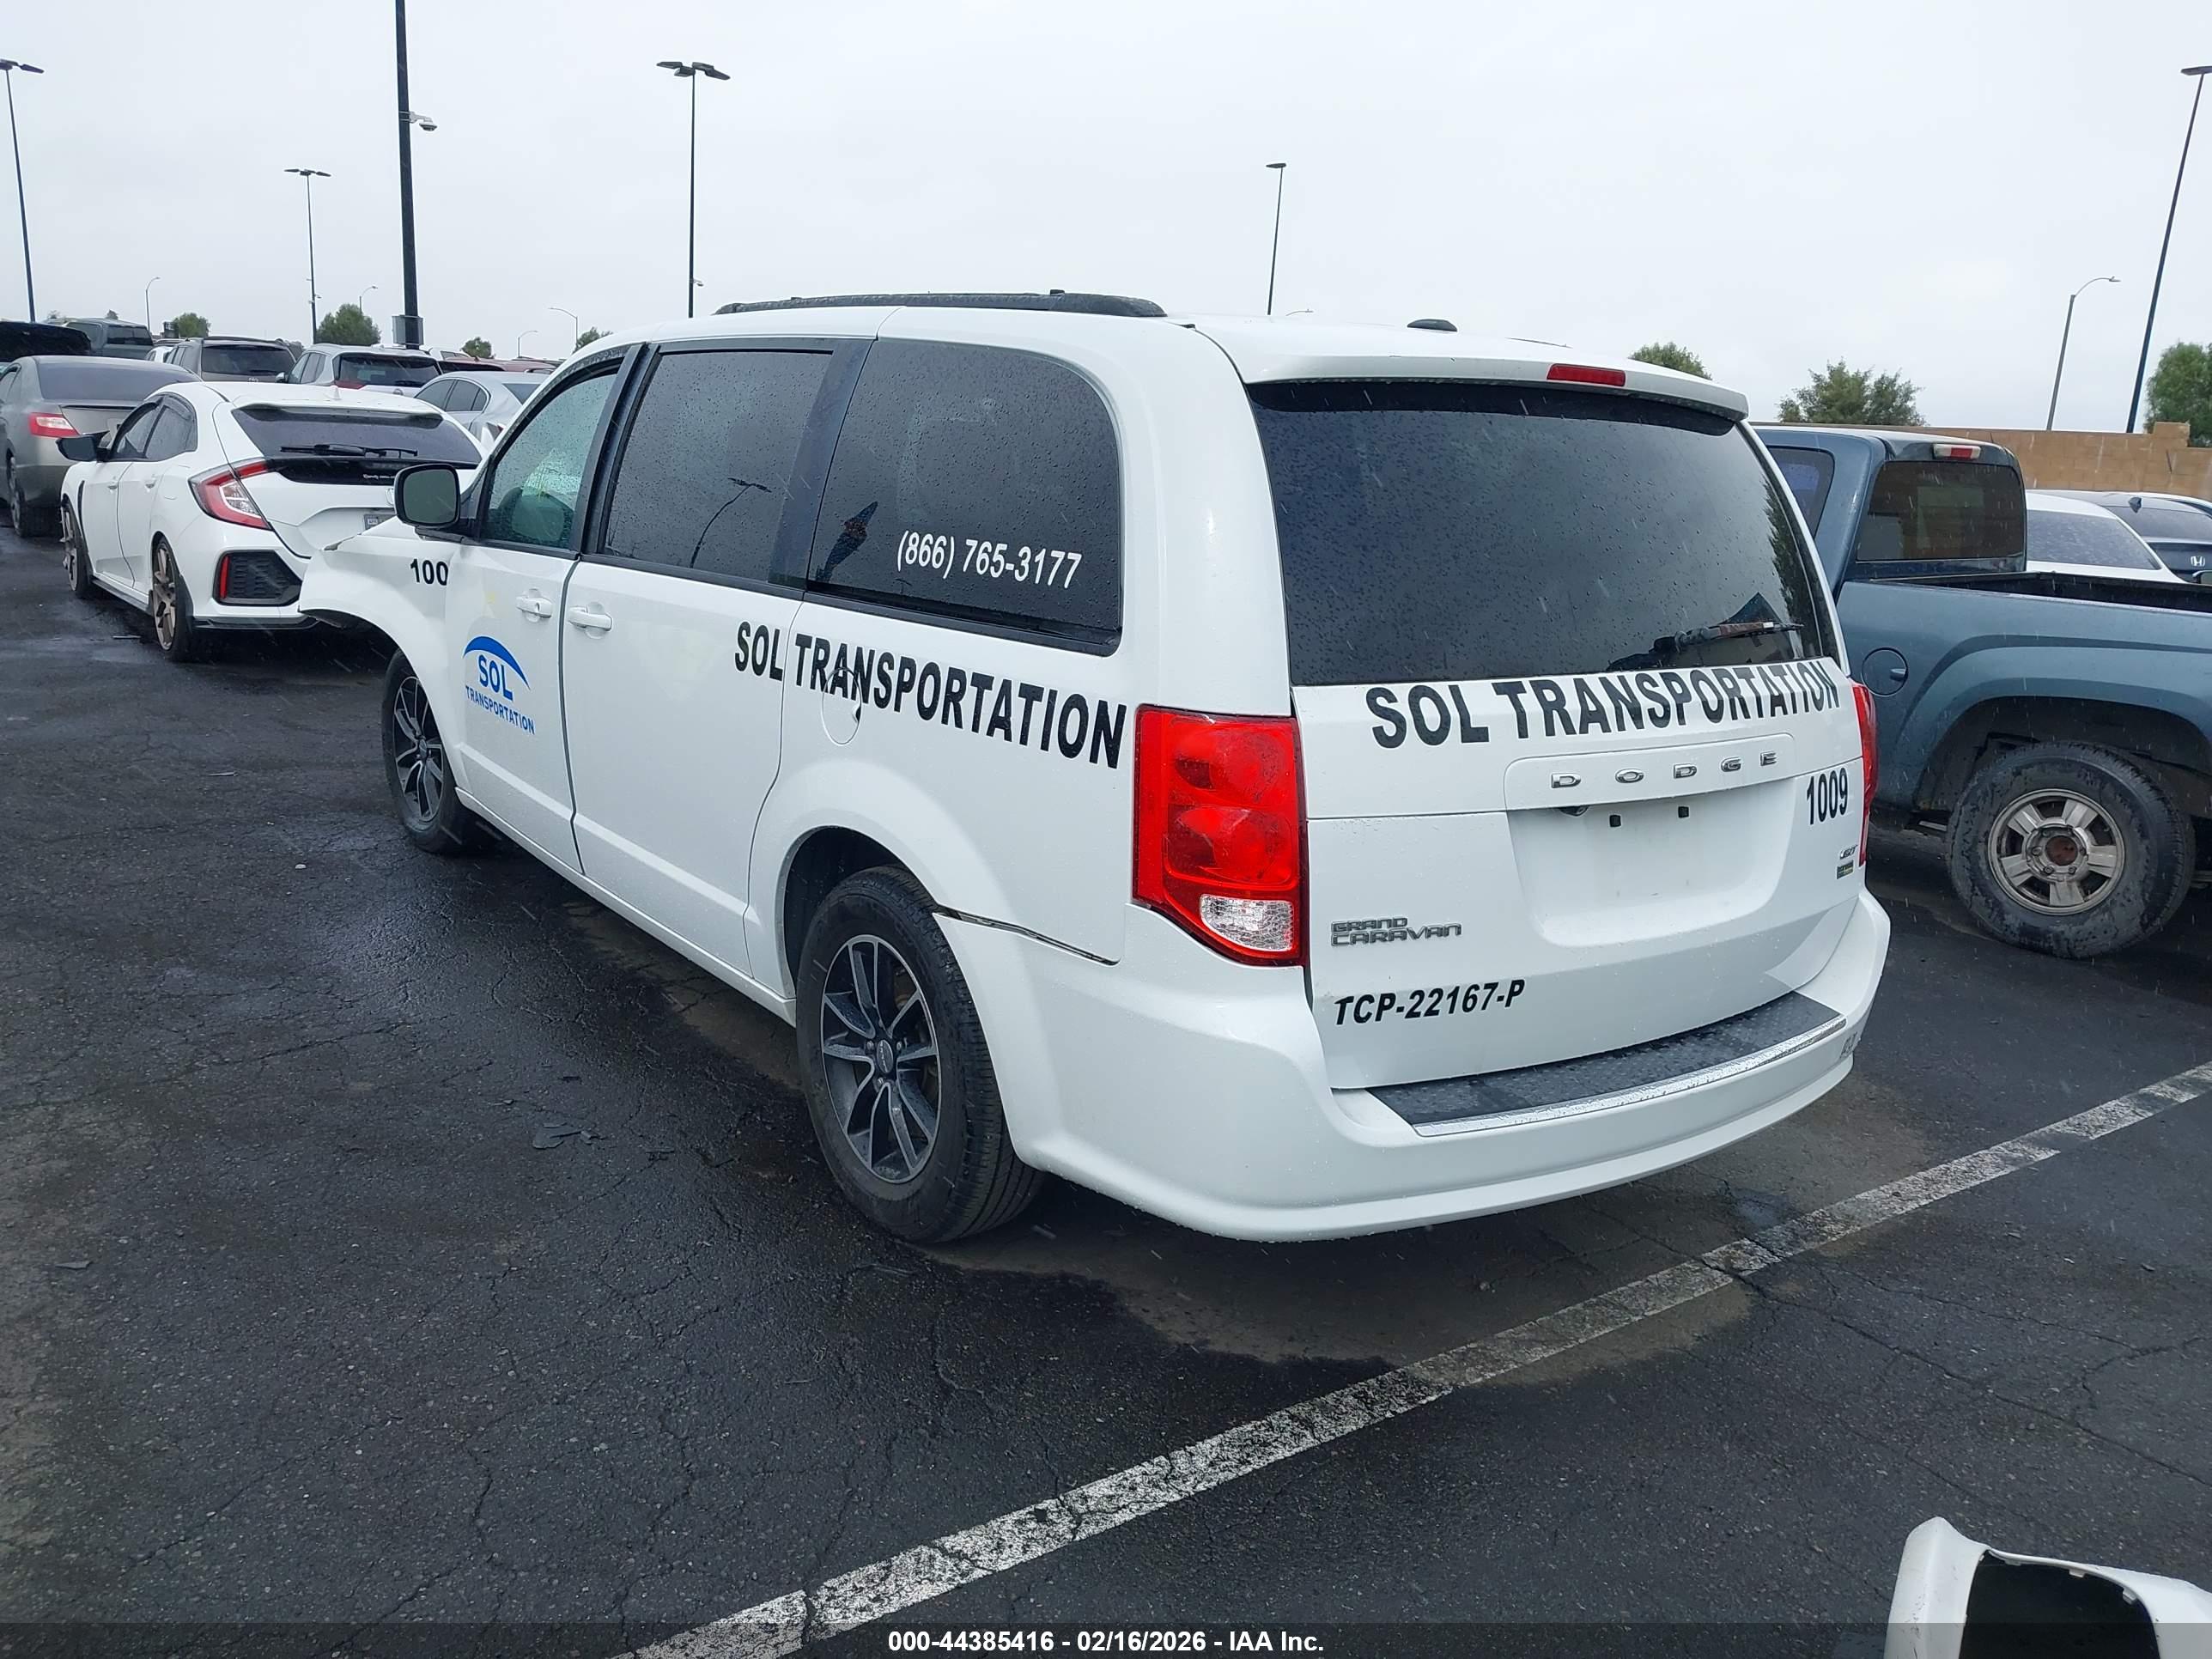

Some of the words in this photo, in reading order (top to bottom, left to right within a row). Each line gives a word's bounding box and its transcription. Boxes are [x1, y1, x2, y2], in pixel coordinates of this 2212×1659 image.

[410, 558, 448, 586] 100
[897, 530, 954, 579] (866)
[963, 540, 1082, 589] 765-3177
[478, 655, 513, 701] SOL
[735, 621, 783, 681] SOL
[795, 634, 1127, 769] TRANSPORTATION
[465, 686, 534, 734] TRANSPORTATION
[1365, 685, 1490, 749] SOL
[1491, 659, 1840, 739] TRANSPORTATION
[1551, 750, 1778, 788] DODGE
[1807, 768, 1848, 824] 1009
[1331, 916, 1408, 933] GRAND
[1331, 923, 1462, 947] CARAVAN
[1334, 979, 1526, 1025] TCP-22167-P
